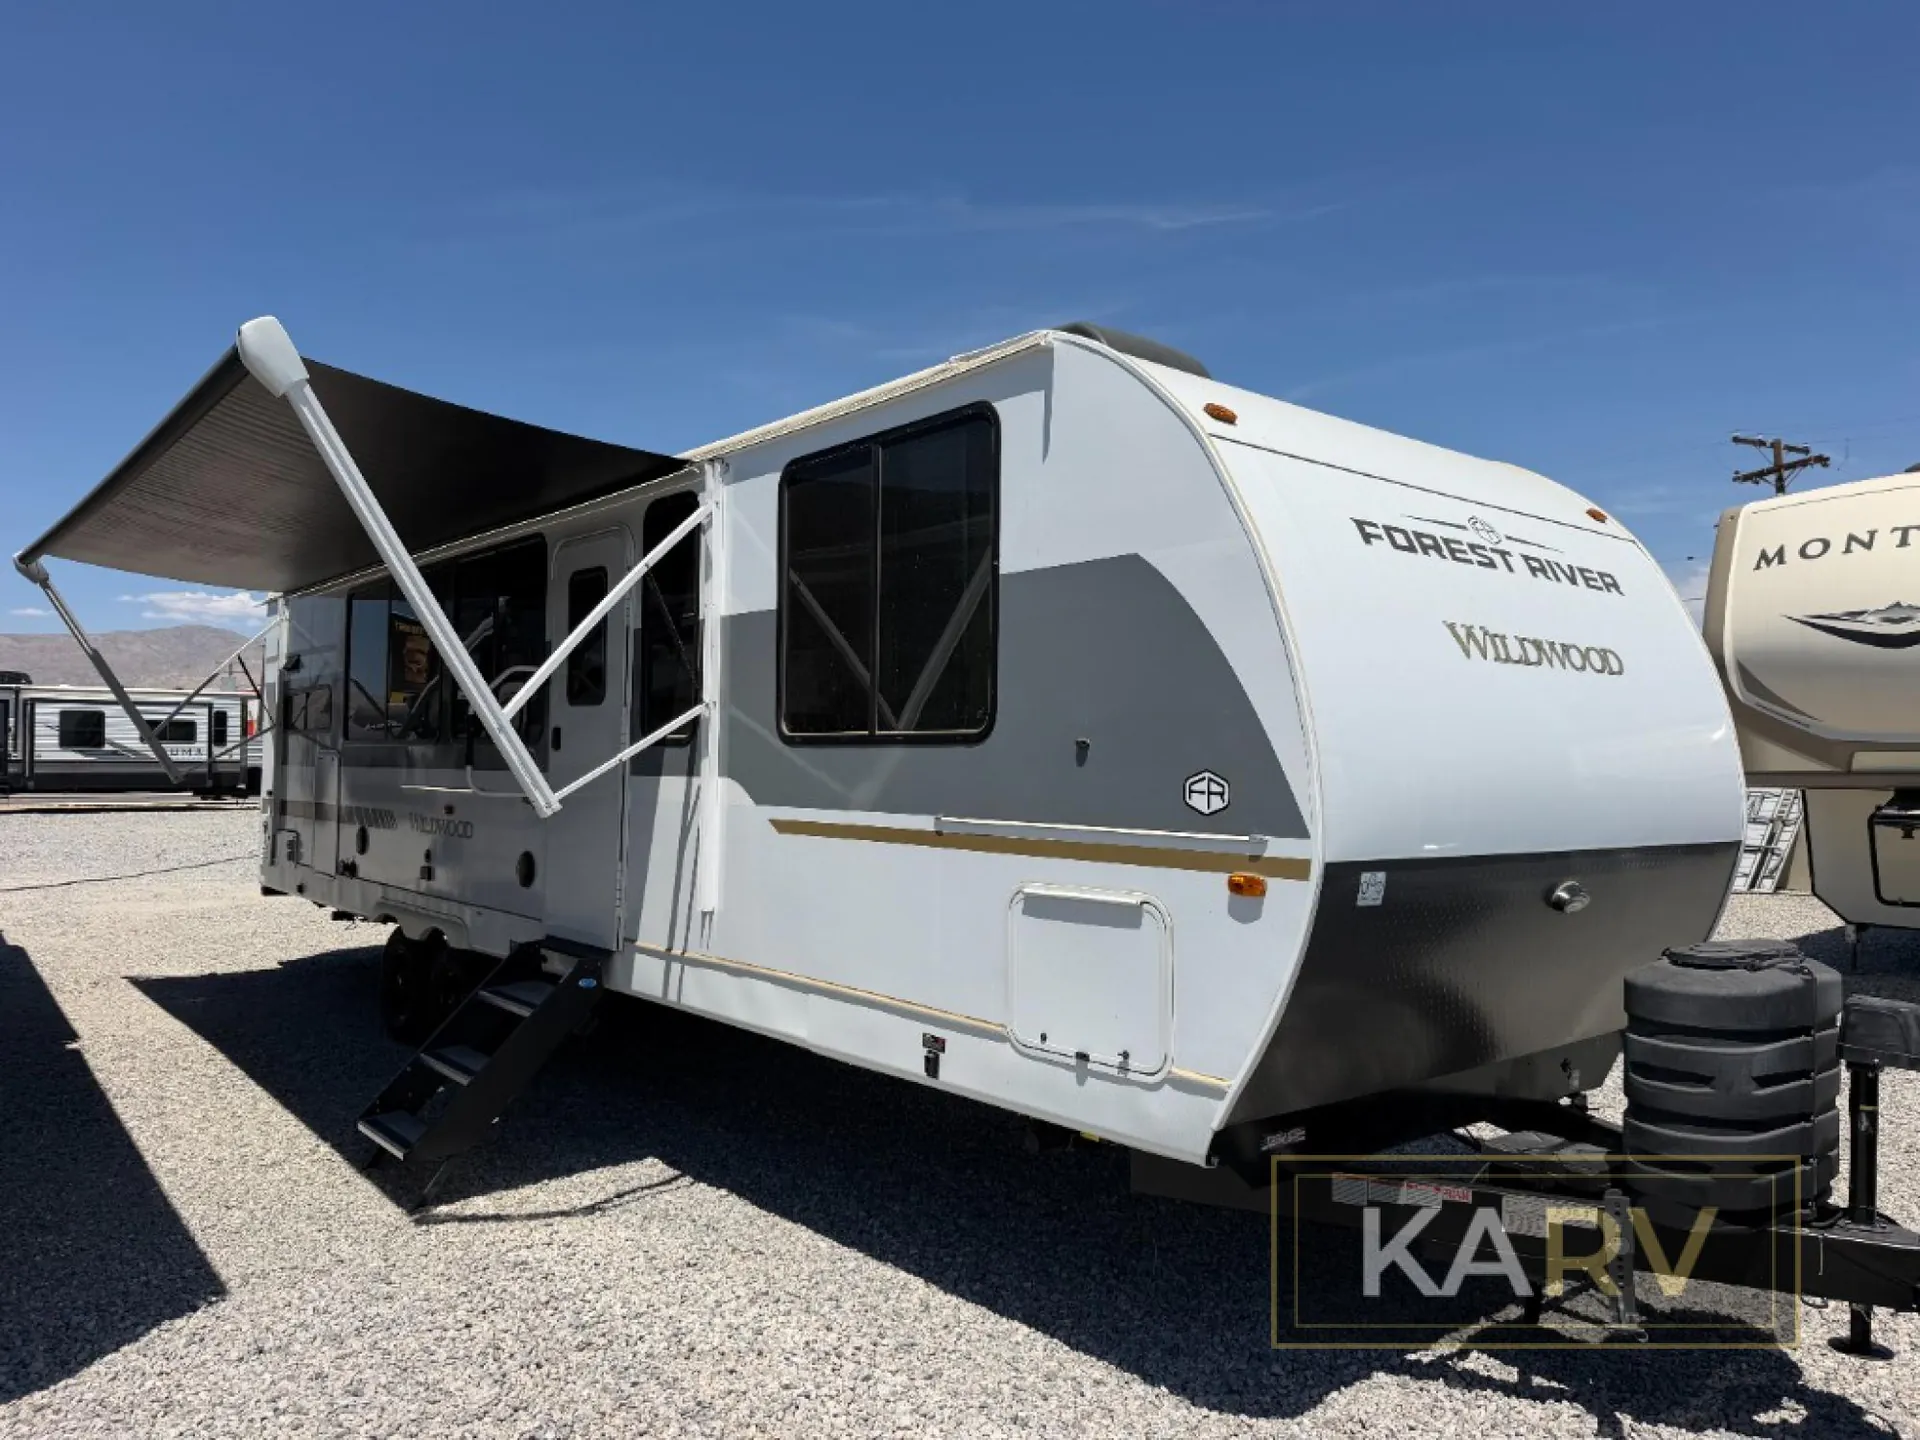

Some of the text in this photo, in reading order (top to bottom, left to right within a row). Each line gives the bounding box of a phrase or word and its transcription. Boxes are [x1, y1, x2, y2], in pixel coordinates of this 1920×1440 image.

[1350, 517, 1516, 573] FOREST
[1520, 553, 1625, 596] RIVER
[1753, 524, 1920, 571] MONT
[1442, 620, 1624, 676] WILDWOOD
[408, 812, 474, 839] WILDWOOD
